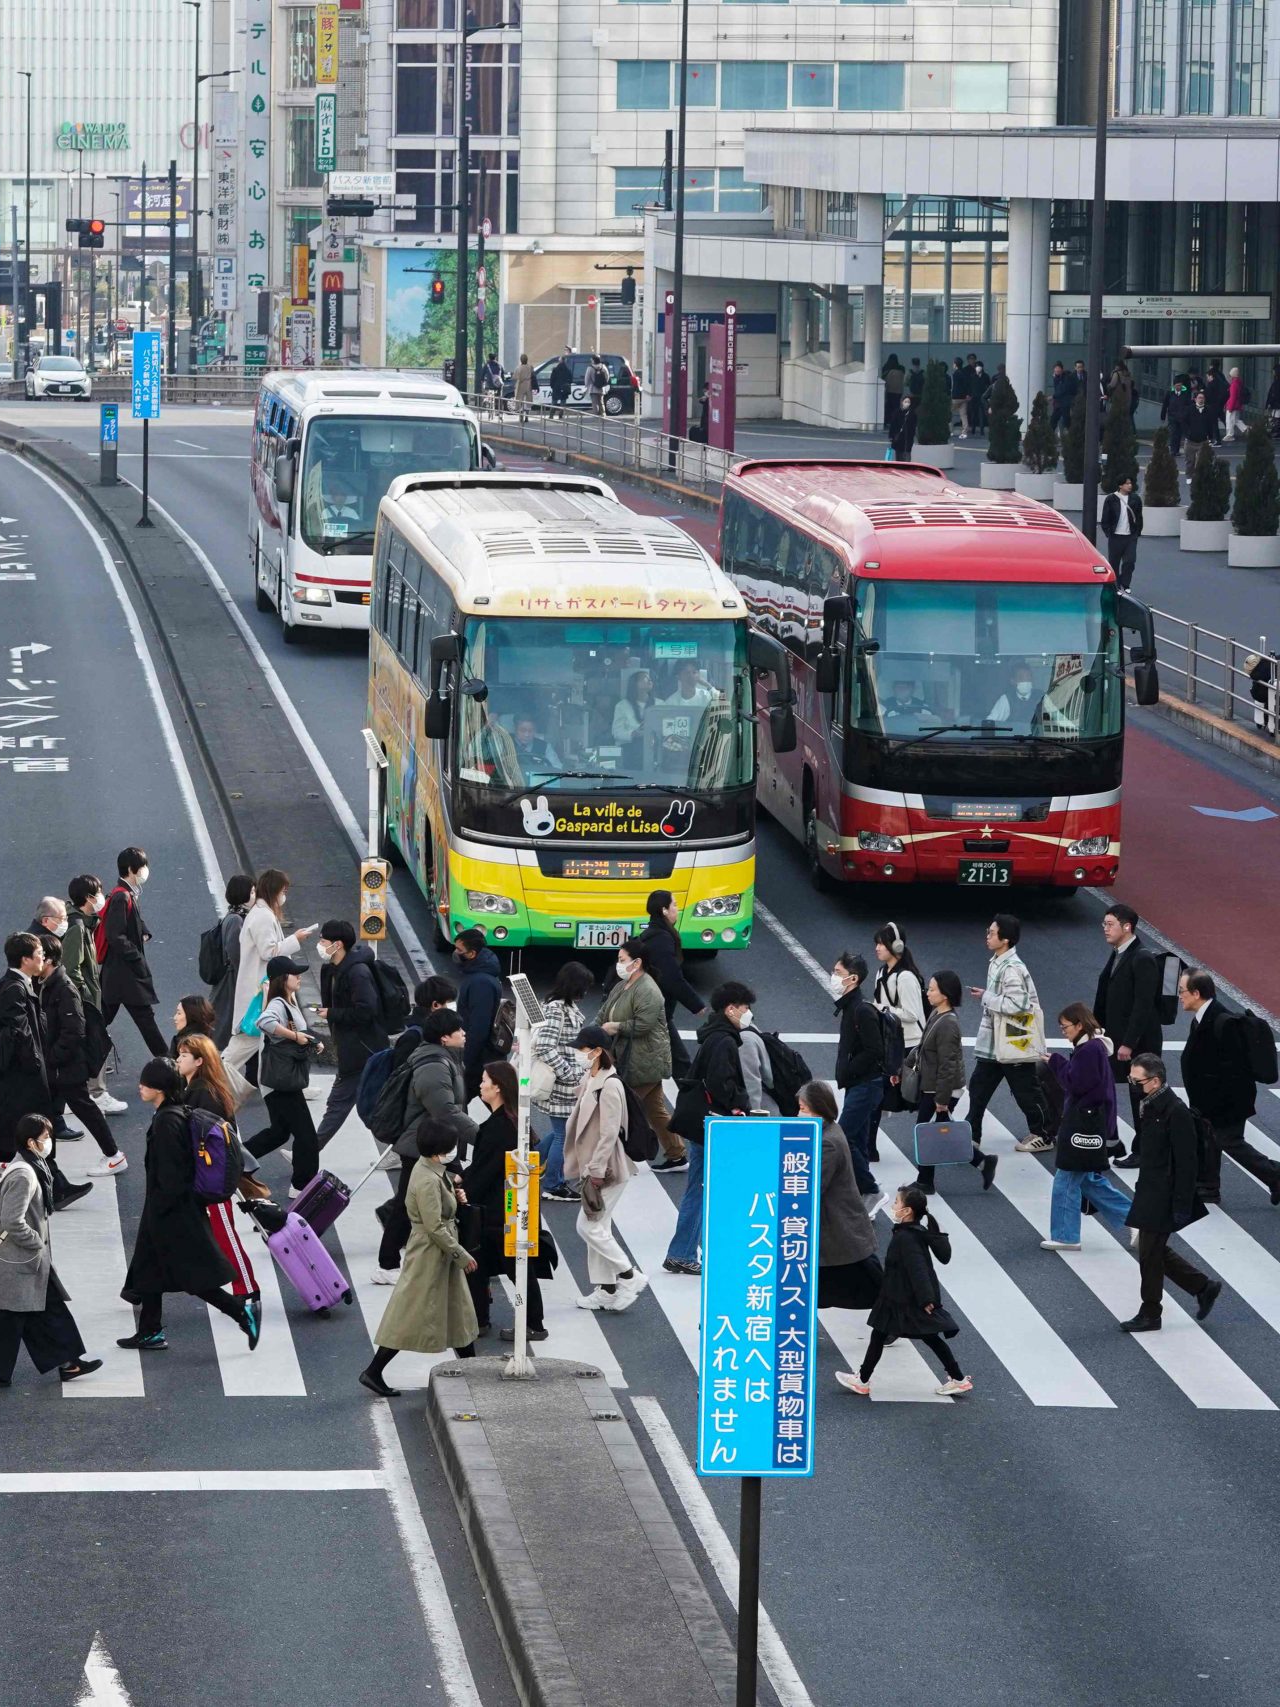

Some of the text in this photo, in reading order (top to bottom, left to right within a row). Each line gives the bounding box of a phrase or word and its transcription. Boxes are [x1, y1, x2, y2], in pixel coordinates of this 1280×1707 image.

[57, 135, 131, 149] CINEMA
[333, 175, 391, 185] バスタ新宿前
[219, 260, 230, 272] P
[328, 293, 337, 347] McDonald's
[134, 380, 142, 417] 入れません
[519, 596, 705, 612] リサとガスパールタウン
[657, 645, 696, 657] 1号車
[573, 803, 642, 818] La ville de
[556, 818, 660, 836] Gaspard et Lisa
[968, 868, 1008, 883] 21-13
[744, 1192, 777, 1402] バスタ新宿へは
[777, 1136, 810, 1464] 一般車・貸切バス・大型貨物車は
[710, 1314, 740, 1464] 入れません
